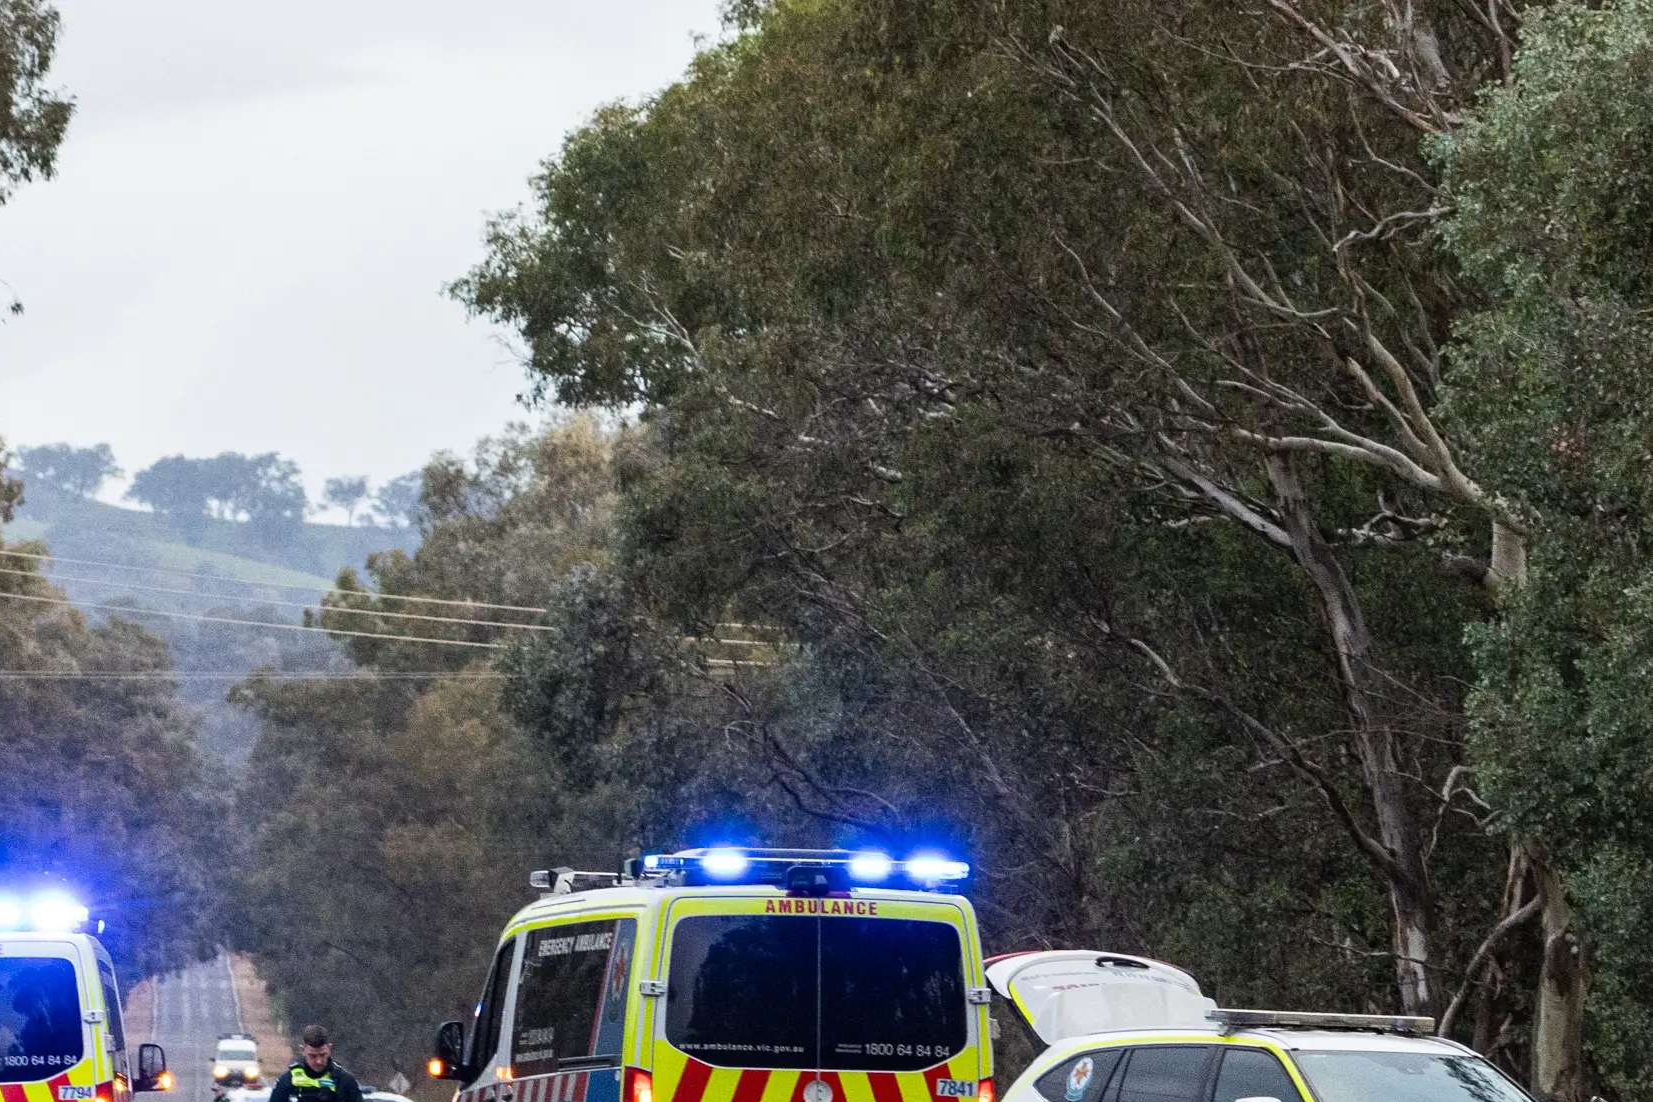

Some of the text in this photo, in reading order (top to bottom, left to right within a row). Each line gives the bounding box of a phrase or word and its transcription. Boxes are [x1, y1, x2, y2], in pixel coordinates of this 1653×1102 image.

[766, 899, 878, 916] AMBULANCE
[679, 1043, 804, 1054] www.ambulance.vic.gov.au
[865, 1043, 894, 1055] 1800
[897, 1044, 913, 1056] 64
[916, 1044, 931, 1057] 84
[934, 1045, 950, 1057] 84
[4, 1055, 29, 1066] 1800
[31, 1055, 45, 1066] 64
[48, 1055, 61, 1066] 84
[64, 1054, 77, 1066] 84
[62, 1086, 92, 1099] 7794
[939, 1080, 973, 1097] 7841
